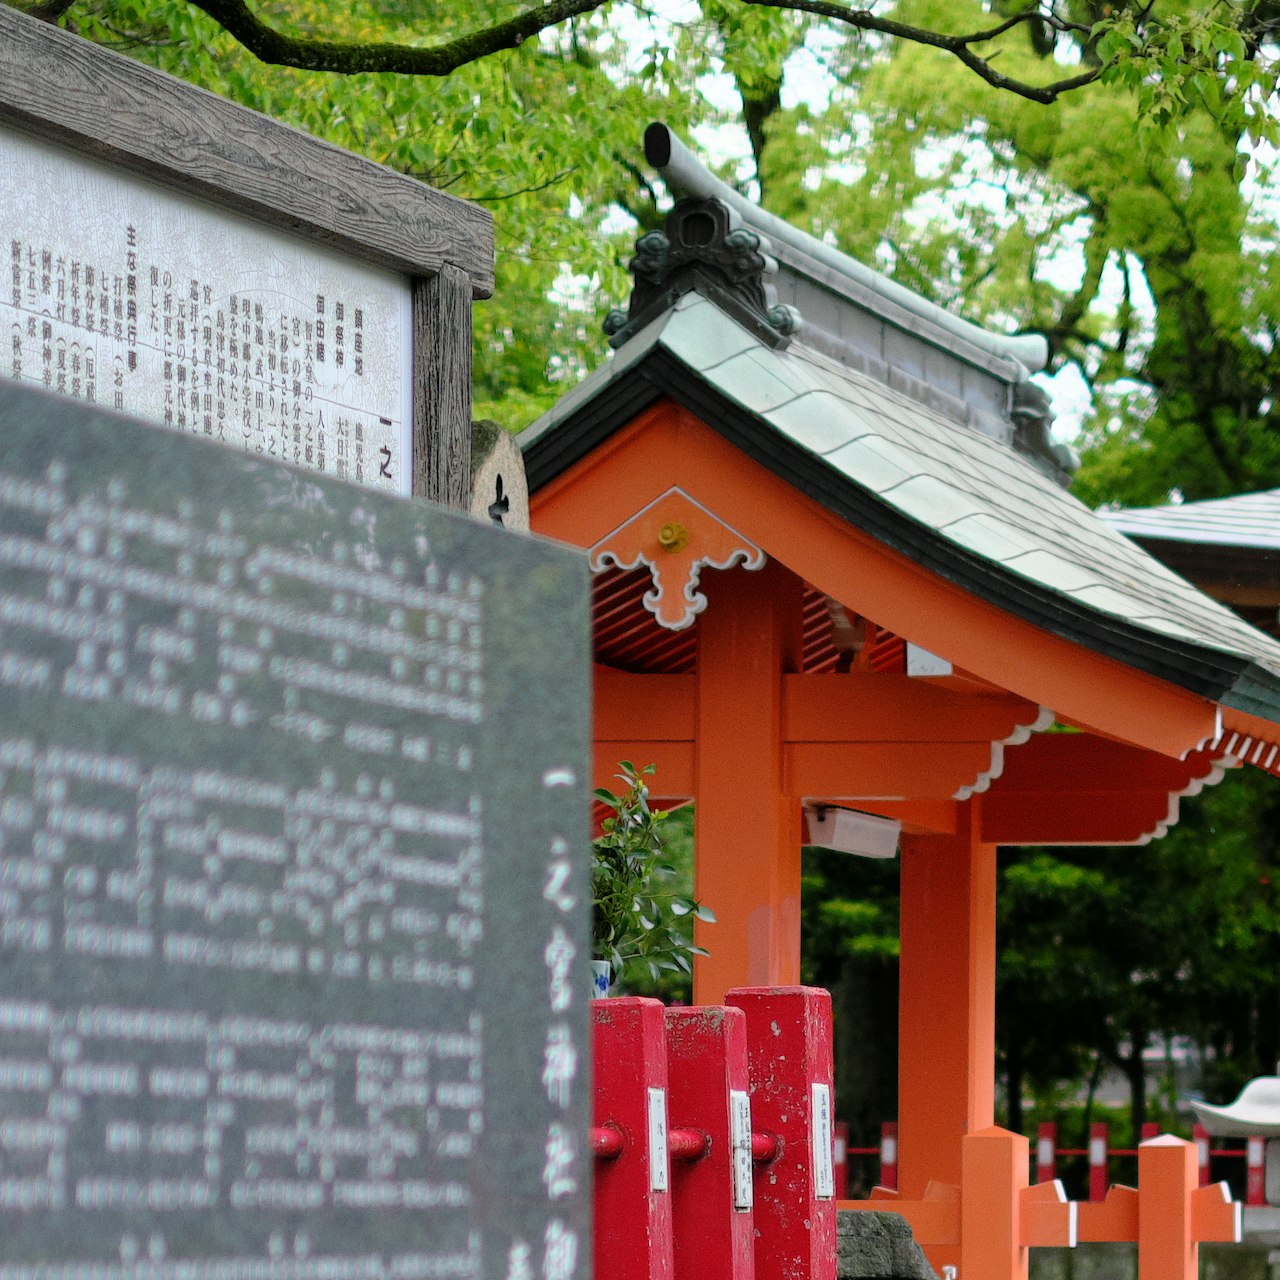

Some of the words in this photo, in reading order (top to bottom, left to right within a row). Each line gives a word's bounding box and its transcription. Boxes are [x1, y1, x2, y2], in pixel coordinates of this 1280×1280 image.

[126, 224, 138, 373] 主な祭典行事
[267, 329, 277, 456] 当初より一之
